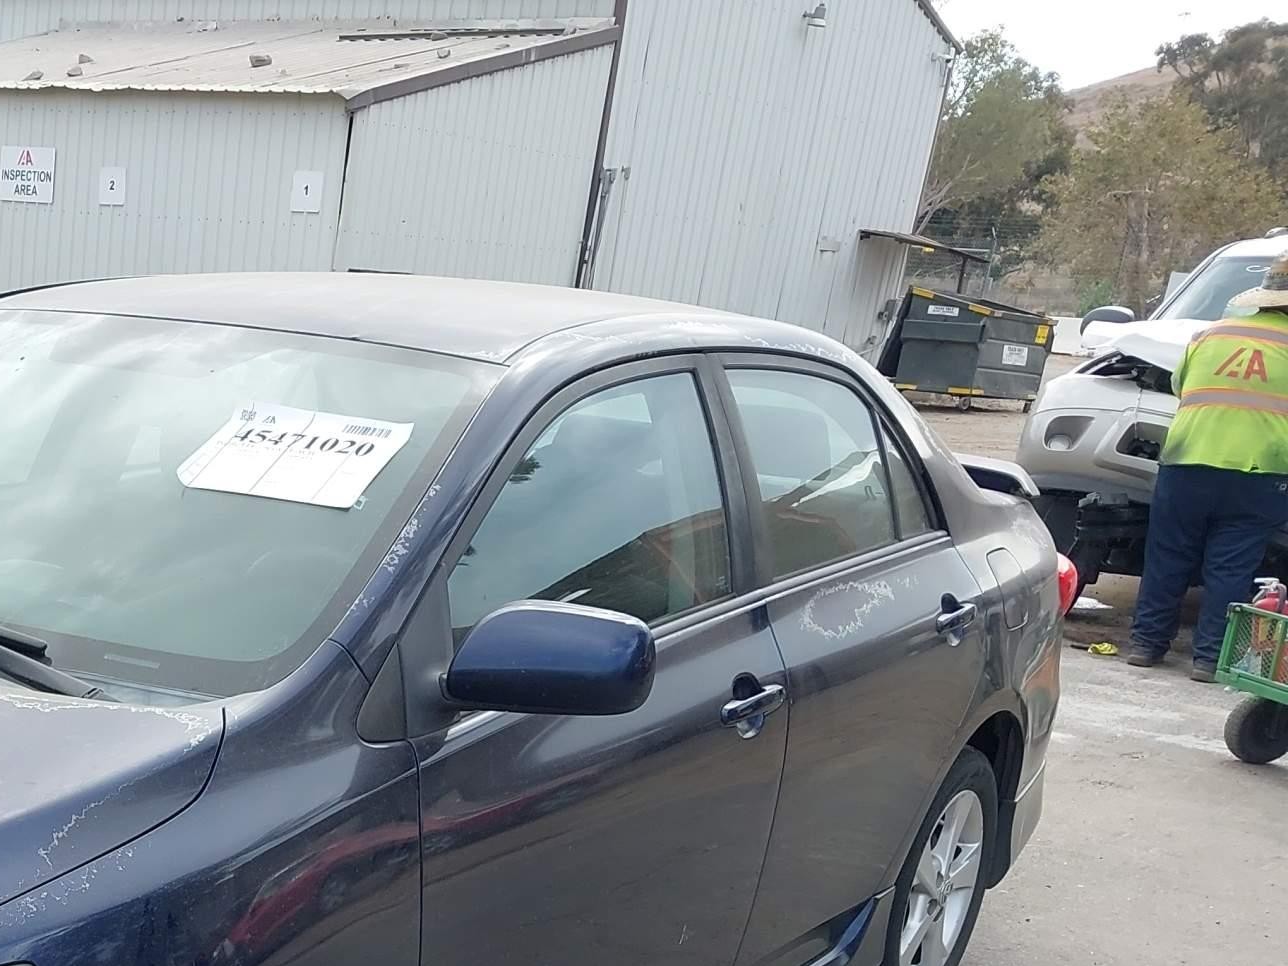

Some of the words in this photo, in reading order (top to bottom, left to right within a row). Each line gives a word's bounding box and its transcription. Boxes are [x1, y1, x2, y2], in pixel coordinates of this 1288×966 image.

[1, 169, 52, 182] INSPECTION
[14, 184, 38, 196] AREA
[109, 180, 115, 191] 2
[304, 184, 309, 196] 1
[234, 428, 376, 457] 45471020
